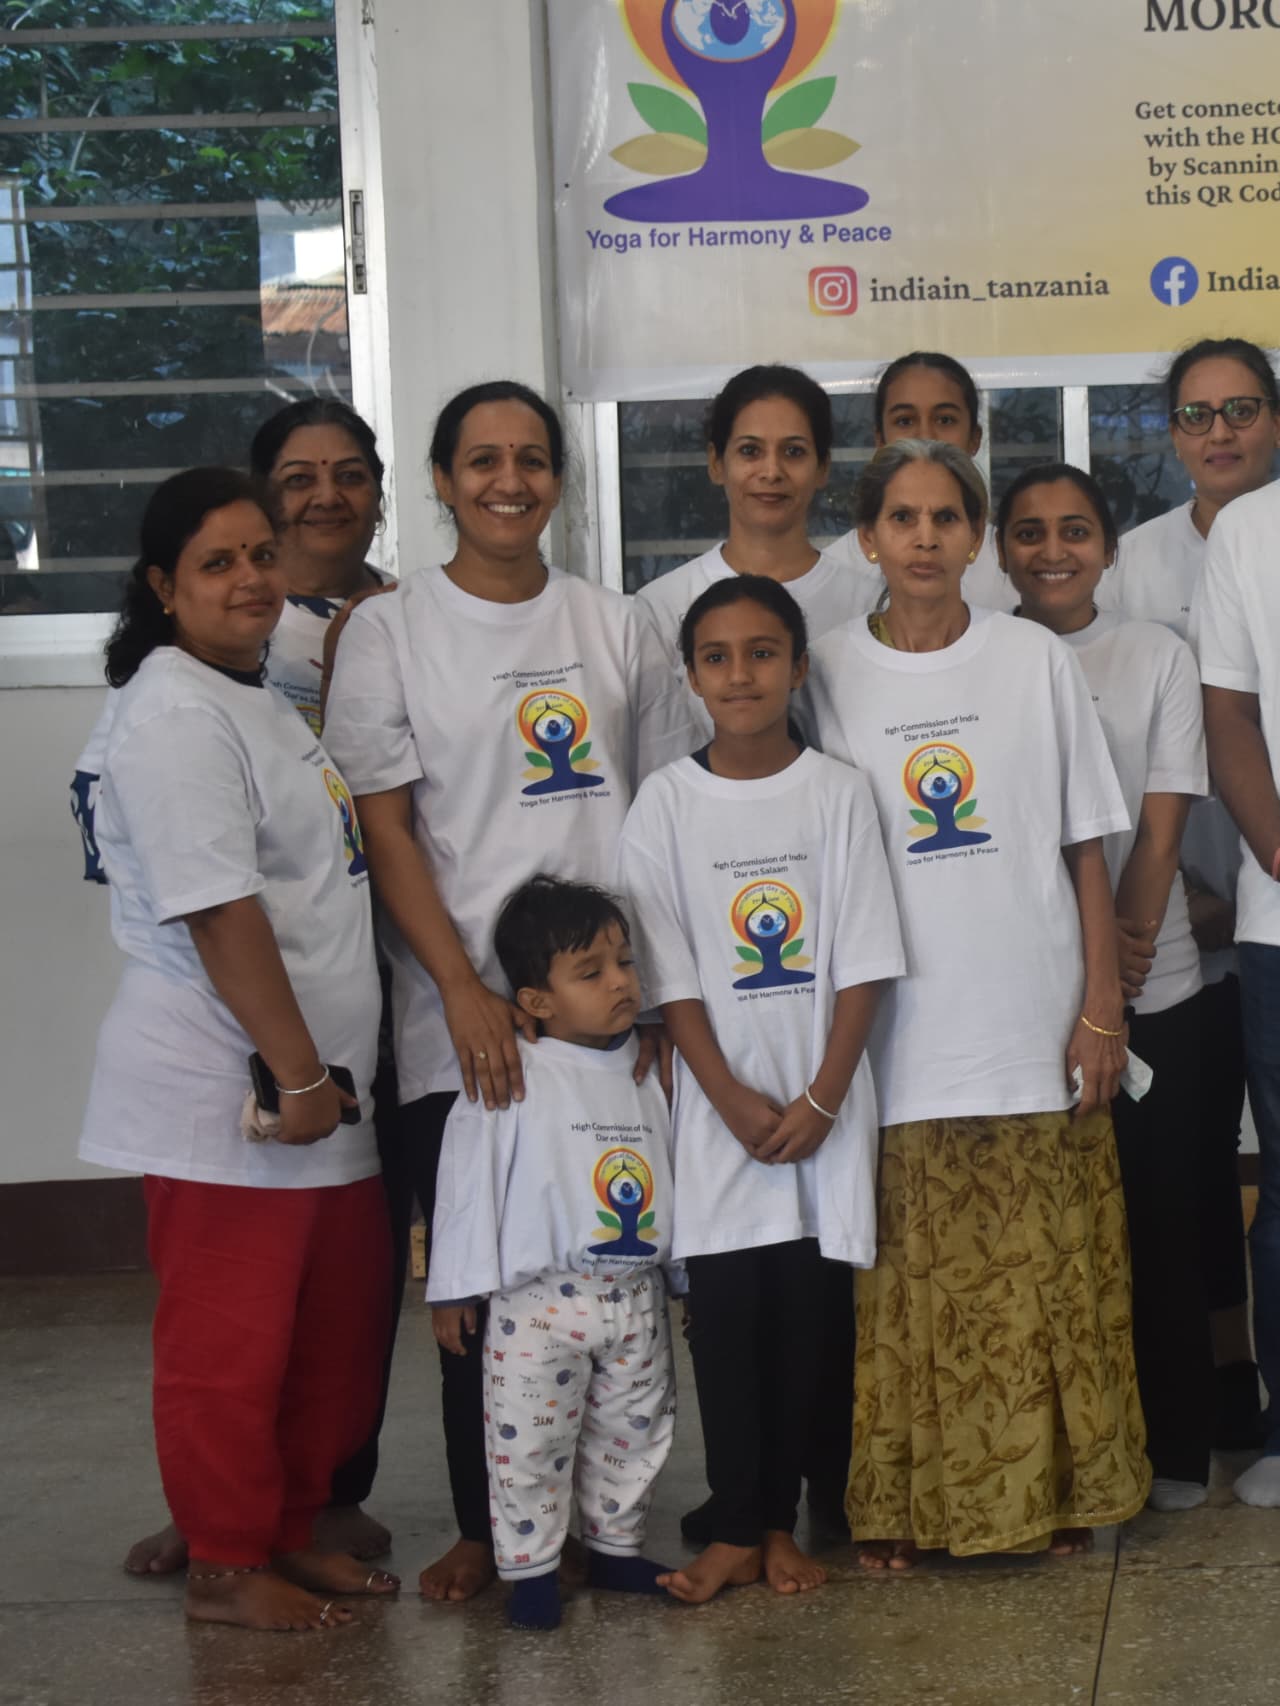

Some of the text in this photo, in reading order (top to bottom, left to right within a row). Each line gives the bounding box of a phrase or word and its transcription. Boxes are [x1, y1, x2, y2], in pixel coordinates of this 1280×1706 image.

[1135, 101, 1176, 120] Get
[1144, 125, 1201, 149] with
[1206, 127, 1246, 147] the
[1148, 155, 1178, 182] by
[1145, 185, 1194, 206] this
[1197, 185, 1234, 207] QR
[586, 222, 892, 254] Yoga for Harmony & Peace
[1207, 266, 1280, 293] India
[869, 272, 1111, 304] indiain_tanzania
[512, 670, 557, 679] Commission
[515, 681, 528, 689] Dar
[539, 677, 567, 686] Salaam
[900, 718, 949, 732] Commission
[950, 716, 958, 724] of
[959, 713, 980, 723] India
[904, 734, 919, 742] Dar
[930, 728, 960, 738] Salaam
[520, 801, 538, 809] Yoga
[552, 792, 582, 803] Harmony
[730, 856, 778, 868] Commission
[779, 853, 787, 862] of
[788, 852, 808, 862] India
[936, 850, 968, 861] Harmony
[969, 848, 975, 856] &
[976, 847, 999, 855] Peace
[733, 870, 748, 879] Dar
[759, 865, 788, 875] Salaam
[749, 992, 758, 1000] for
[794, 987, 800, 995] &
[800, 986, 815, 994] Pea
[571, 1122, 592, 1132] High
[592, 1122, 633, 1132] Commission
[633, 1124, 641, 1132] of
[595, 1133, 609, 1142] Dar
[603, 1454, 626, 1470] NYC
[514, 1553, 530, 1564] 38
